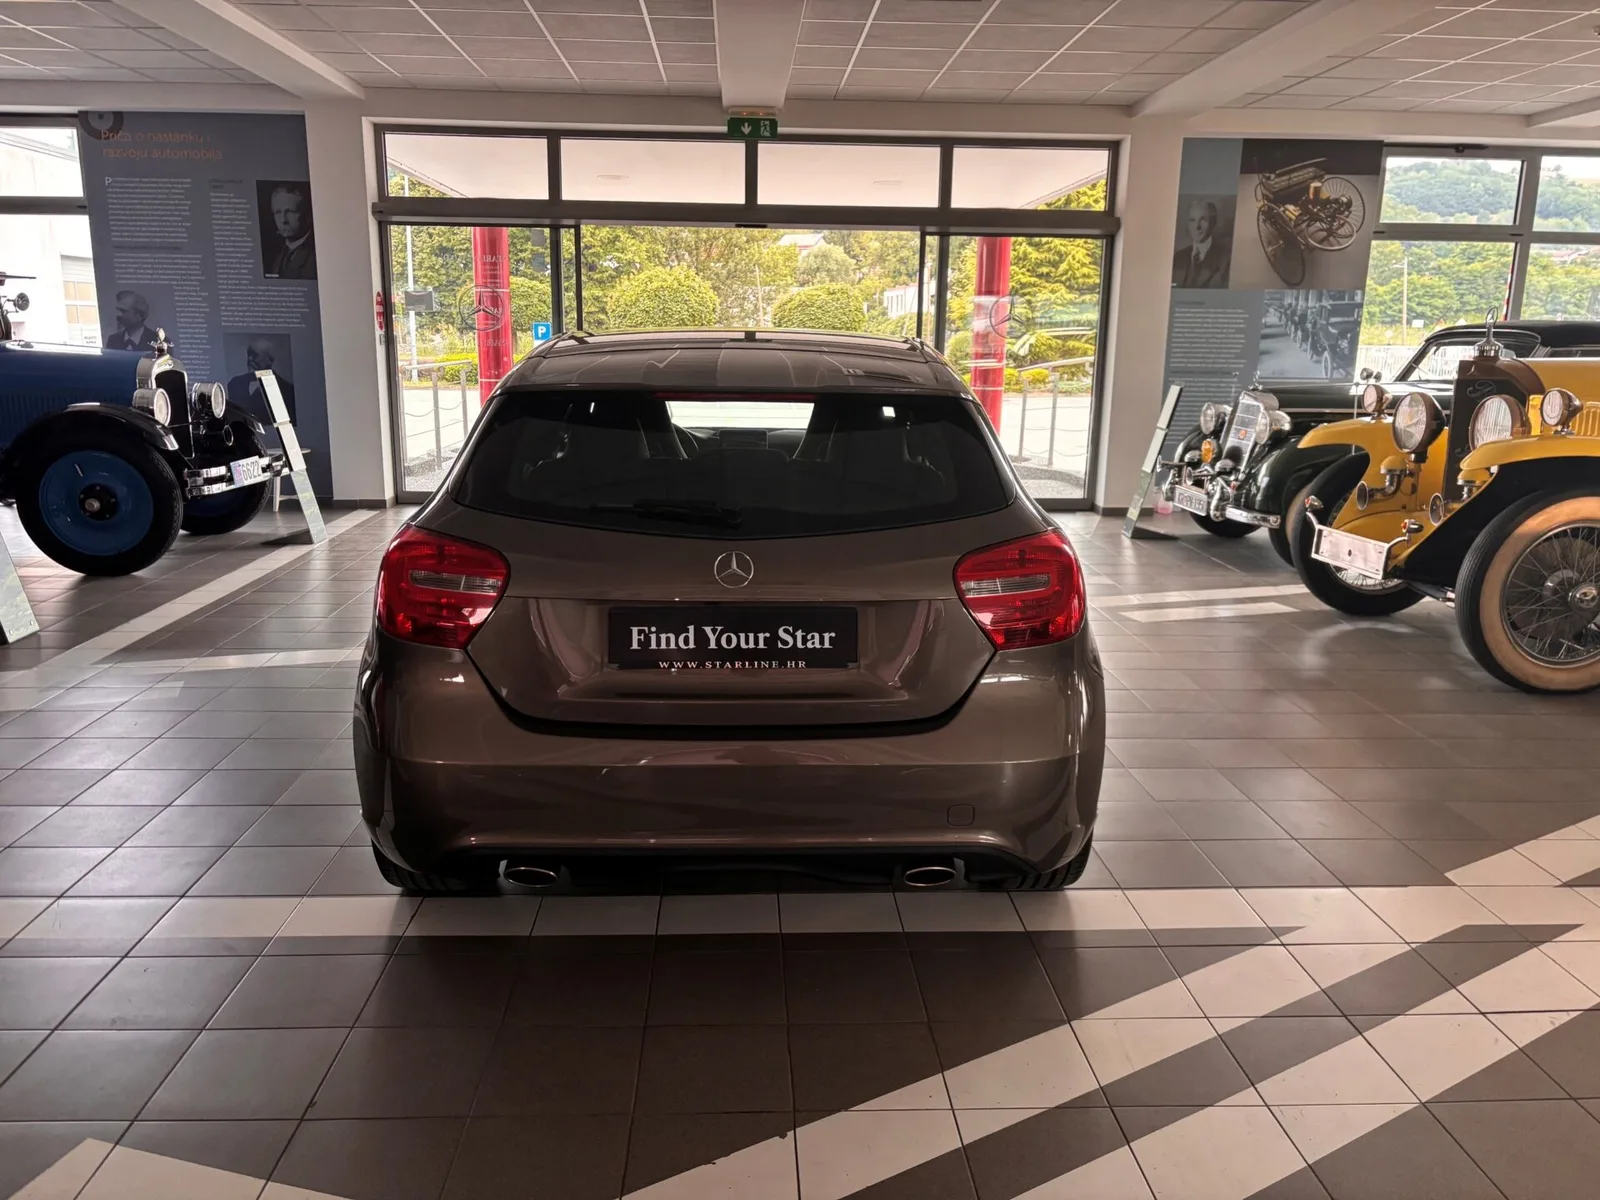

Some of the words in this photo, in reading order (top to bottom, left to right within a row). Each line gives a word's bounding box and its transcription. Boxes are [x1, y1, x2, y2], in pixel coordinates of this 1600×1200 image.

[135, 132, 145, 141] o
[148, 131, 203, 143] nastanku
[102, 148, 148, 161] razvoju
[151, 148, 223, 160] automobila
[241, 460, 262, 481] 6622
[630, 624, 697, 650] Find
[702, 625, 771, 649] Your
[777, 625, 836, 649] Star
[658, 660, 807, 669] WWW.STARLINE.HR
